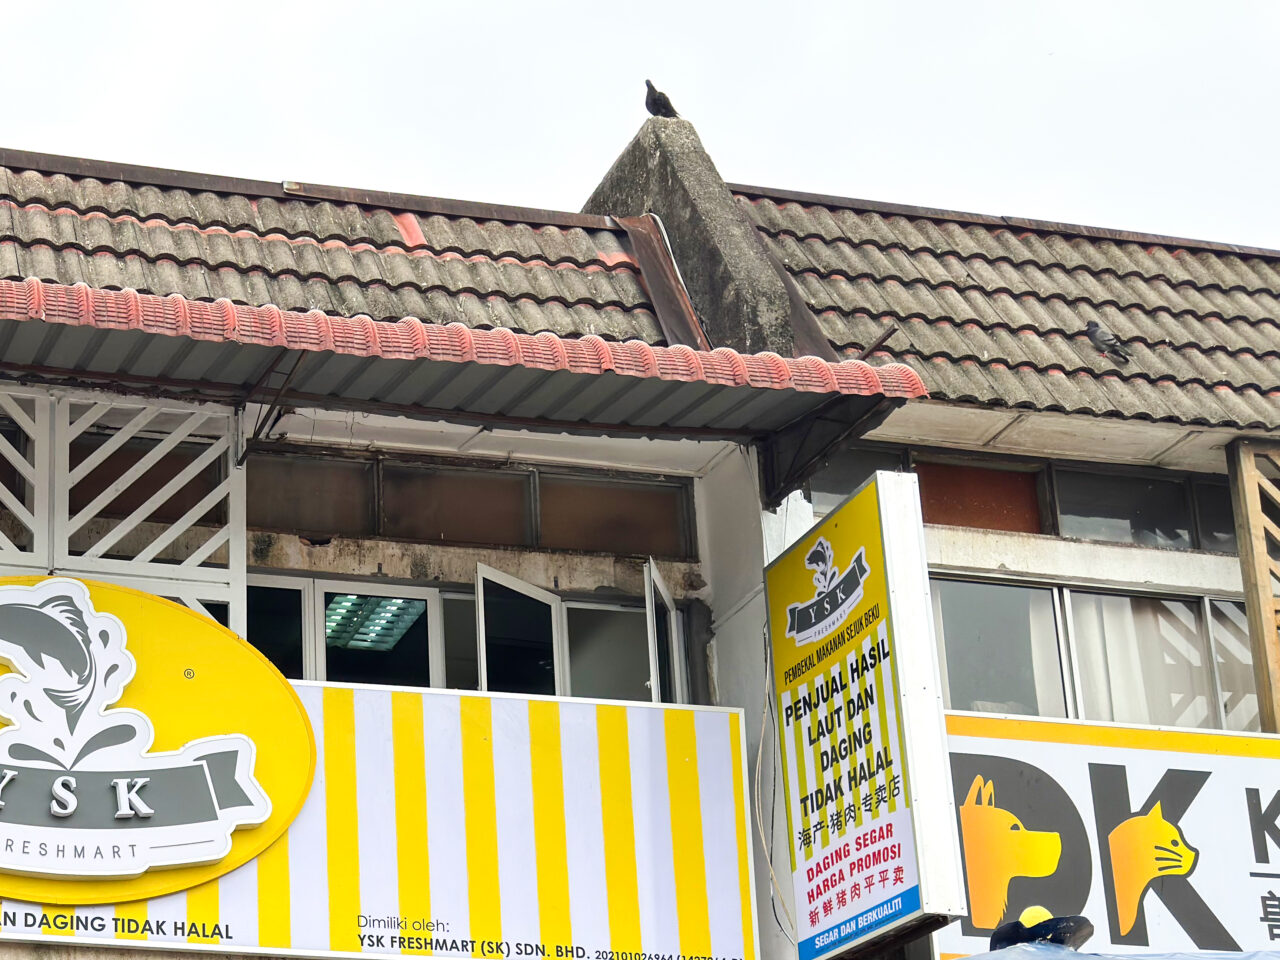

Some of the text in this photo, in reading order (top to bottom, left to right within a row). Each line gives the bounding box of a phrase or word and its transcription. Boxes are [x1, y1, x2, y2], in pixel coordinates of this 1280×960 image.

[809, 584, 847, 624] YSK
[784, 603, 880, 686] PEMBEKAL MAKANAN SEJUK BEKU
[785, 639, 890, 726] PENJUAL HASIL
[808, 684, 875, 747] LAUT DAN
[820, 722, 873, 773] DAGING
[800, 746, 893, 817] TIDAK HALAL
[806, 823, 893, 883] DAGING SEGAR
[807, 843, 901, 905] HARGA PROMOSI
[23, 912, 106, 932] DAGING
[111, 917, 167, 936] TIDAK
[173, 921, 234, 940] HALAL
[357, 915, 450, 933] Dimiliki oleh:
[808, 866, 905, 928] 新鲜猪肉平平卖
[815, 928, 839, 949] SEGAR
[840, 920, 856, 937] DAN
[858, 897, 902, 929] BERKUALITI
[357, 934, 385, 948] YSK
[390, 936, 476, 953] FRESHMART
[481, 941, 511, 958] (SK)
[515, 943, 551, 957] SDN.
[555, 945, 590, 959] BHD.
